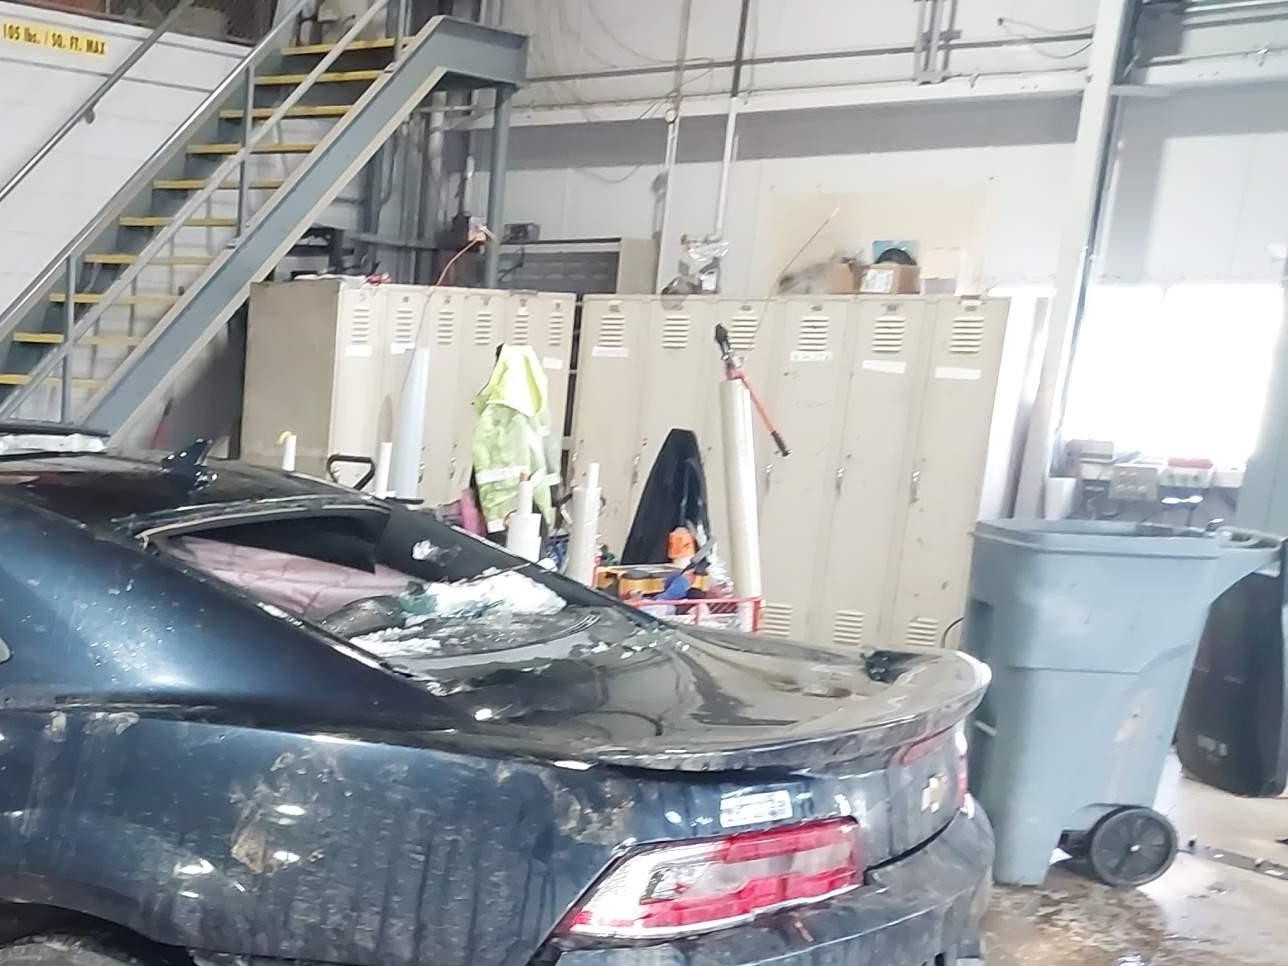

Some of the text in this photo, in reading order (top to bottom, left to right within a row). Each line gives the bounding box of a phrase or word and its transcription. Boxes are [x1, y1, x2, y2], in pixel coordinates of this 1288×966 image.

[3, 23, 20, 40] 105
[24, 27, 40, 44] lbs.
[52, 32, 66, 49] SQ.
[70, 36, 82, 52] FT.
[86, 39, 105, 54] MAX
